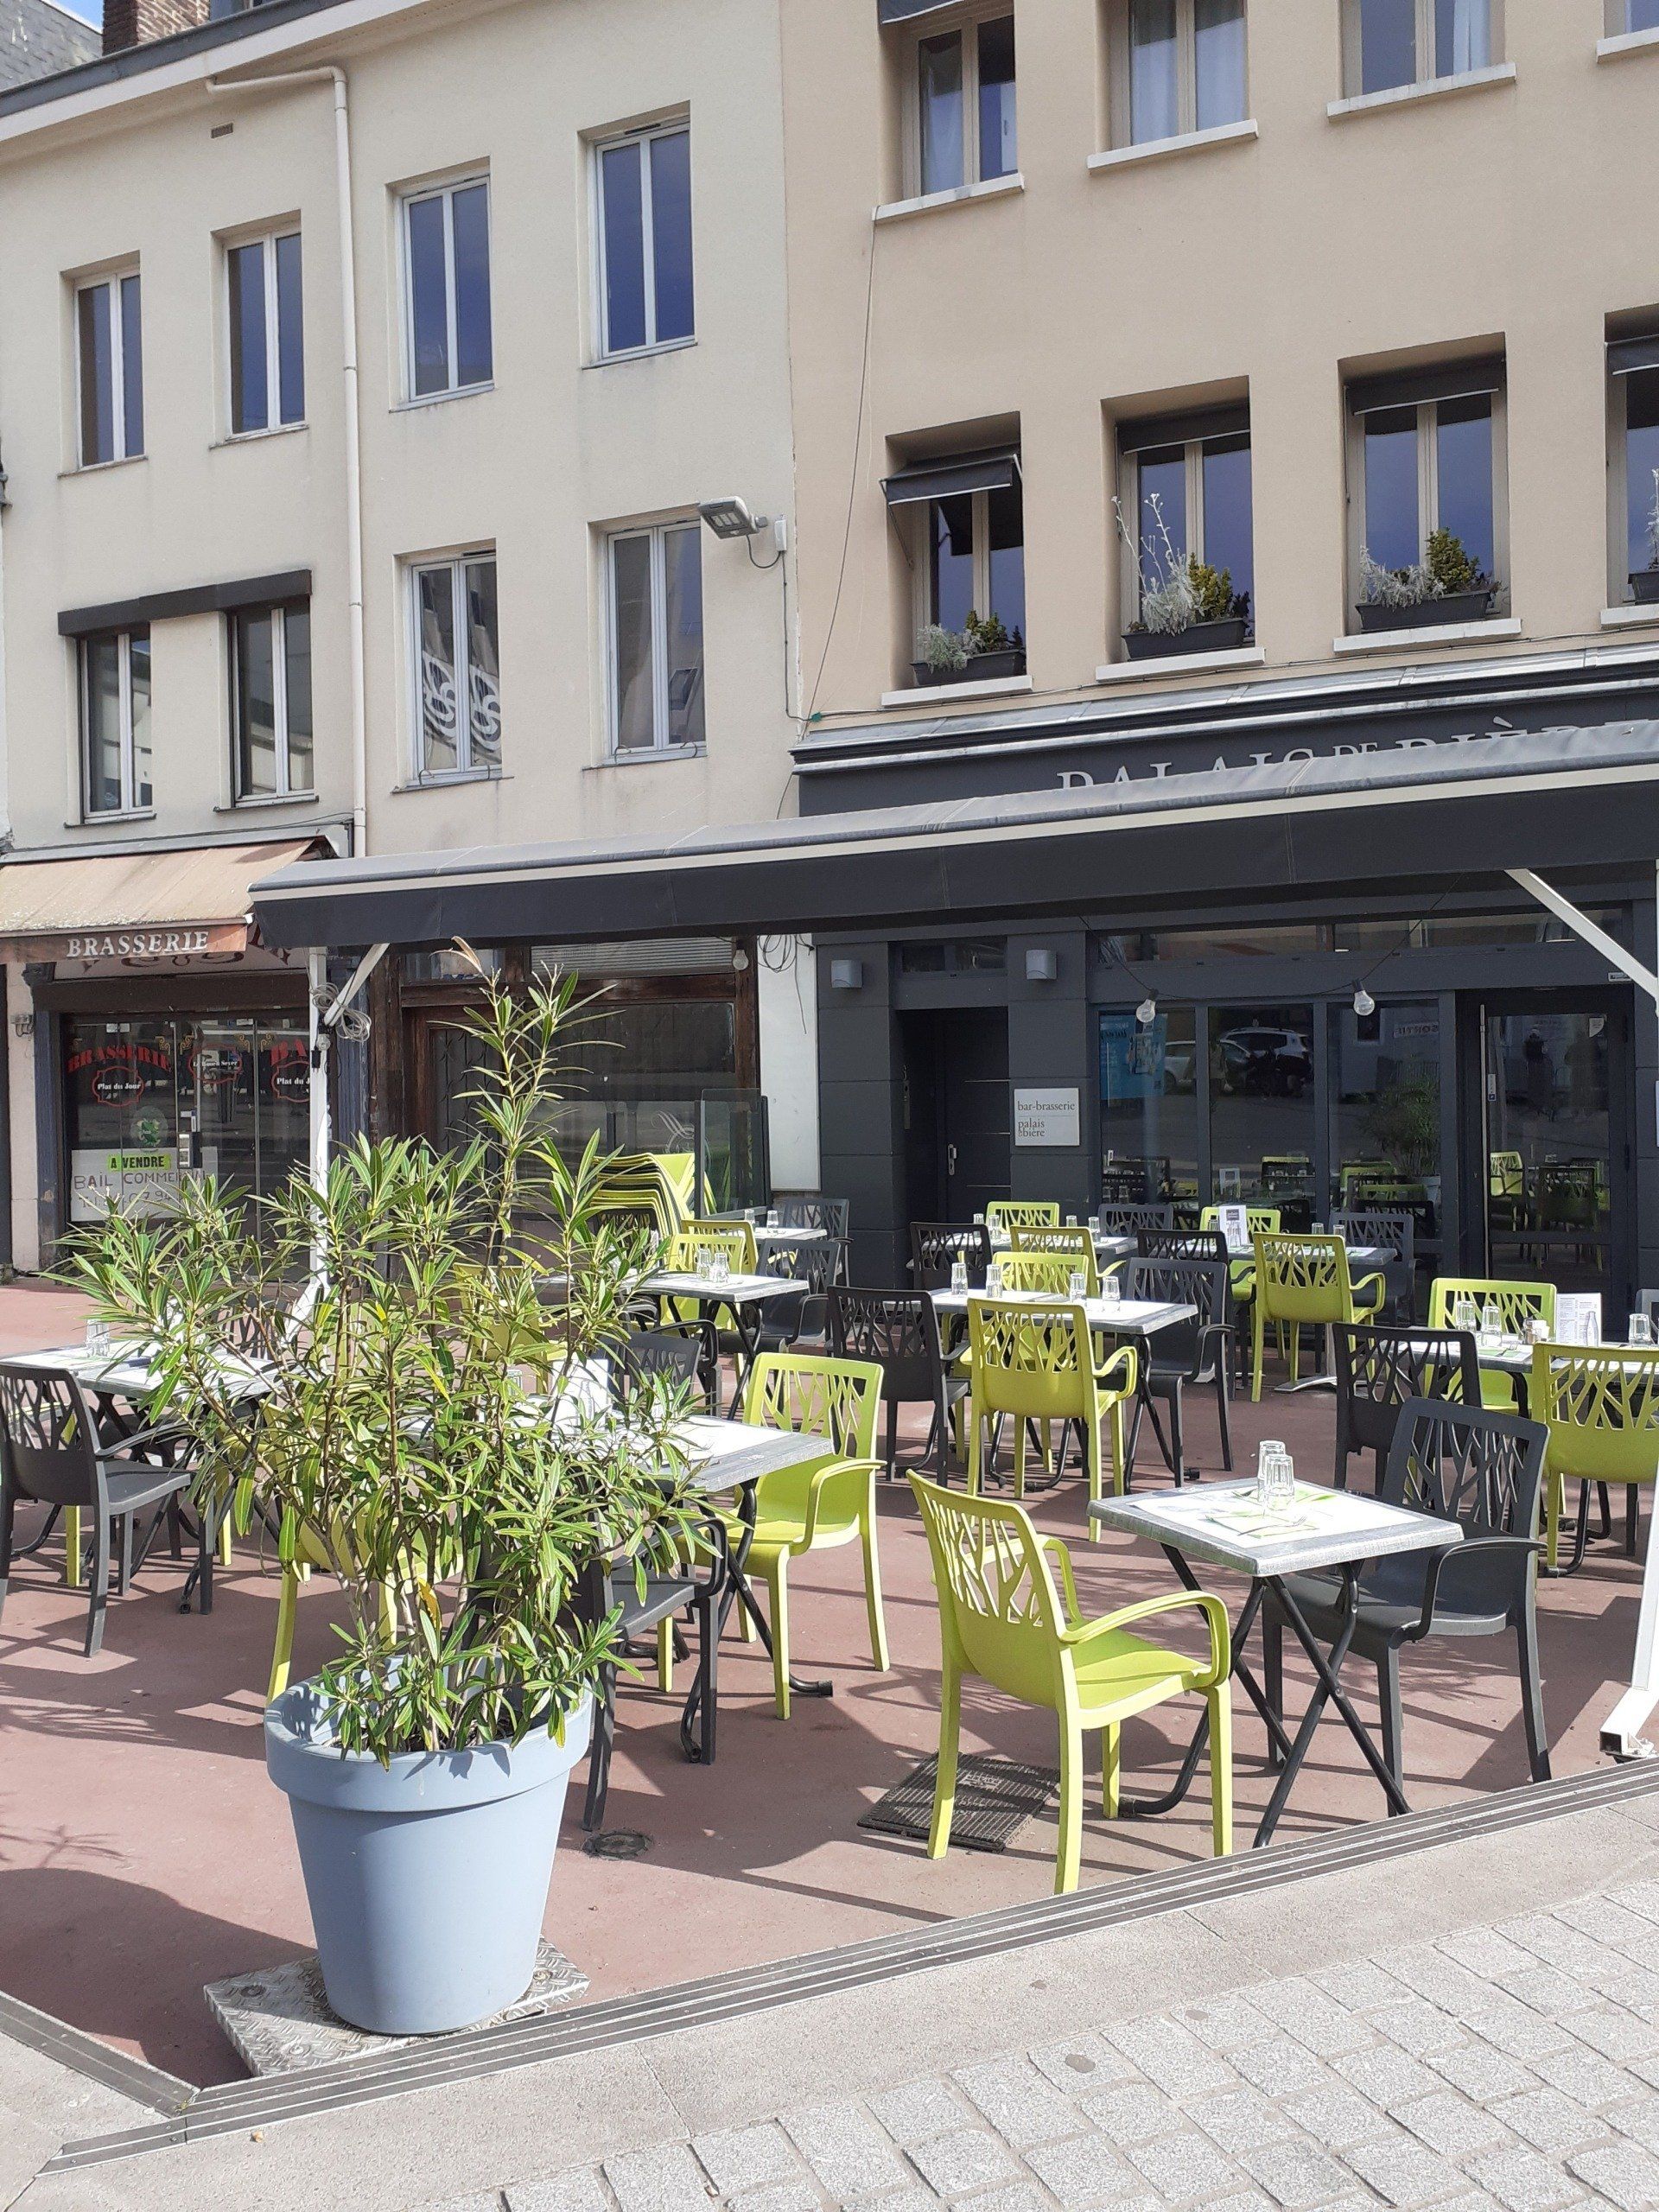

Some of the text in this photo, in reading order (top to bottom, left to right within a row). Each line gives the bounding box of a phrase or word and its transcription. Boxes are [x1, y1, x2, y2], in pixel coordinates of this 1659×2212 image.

[67, 931, 209, 958] BRASSERIE
[276, 1077, 292, 1085] Plat
[294, 1077, 304, 1085] du
[1017, 1100, 1075, 1111] bar-brasserie
[1018, 1117, 1046, 1129] palais
[110, 1156, 165, 1169] A VENDRE
